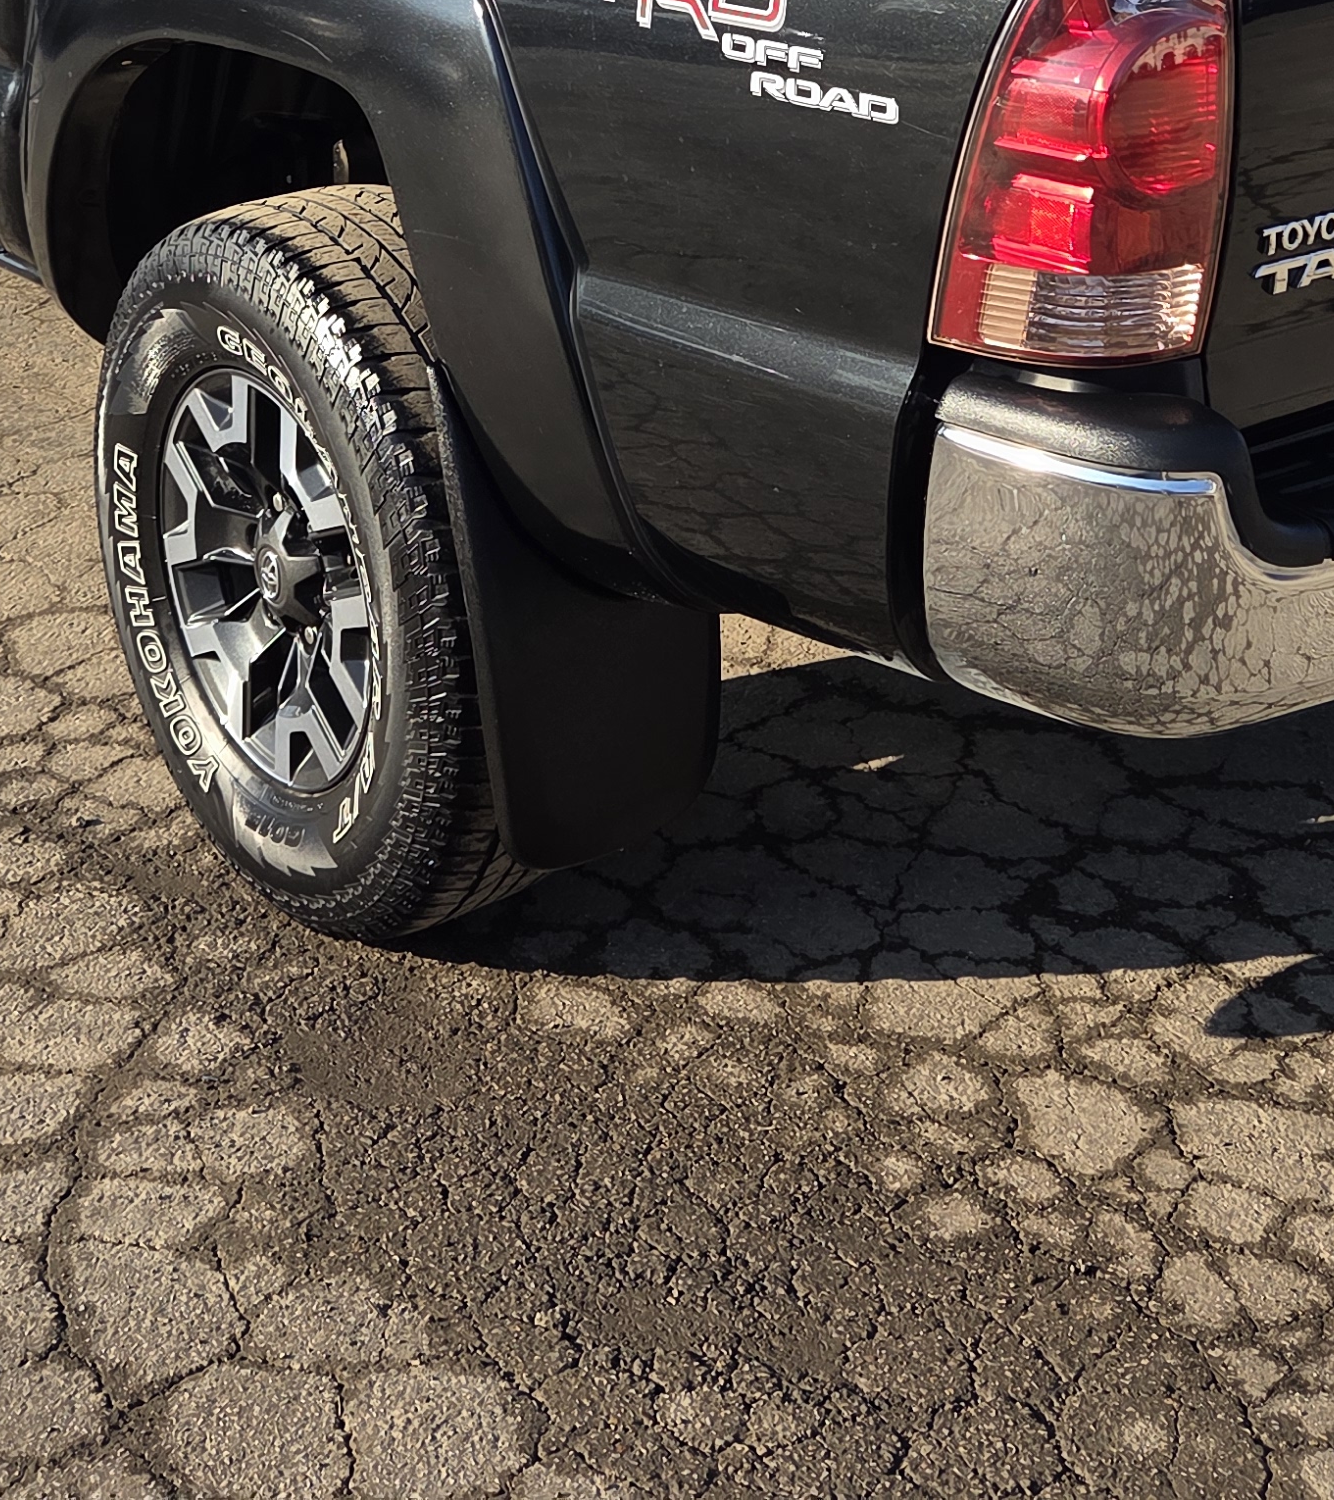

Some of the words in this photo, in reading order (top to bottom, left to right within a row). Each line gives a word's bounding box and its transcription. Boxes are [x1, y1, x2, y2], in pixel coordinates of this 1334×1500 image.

[721, 31, 825, 73] OFF
[749, 71, 900, 125] ROAD
[114, 443, 219, 793] YOKOHAMA
